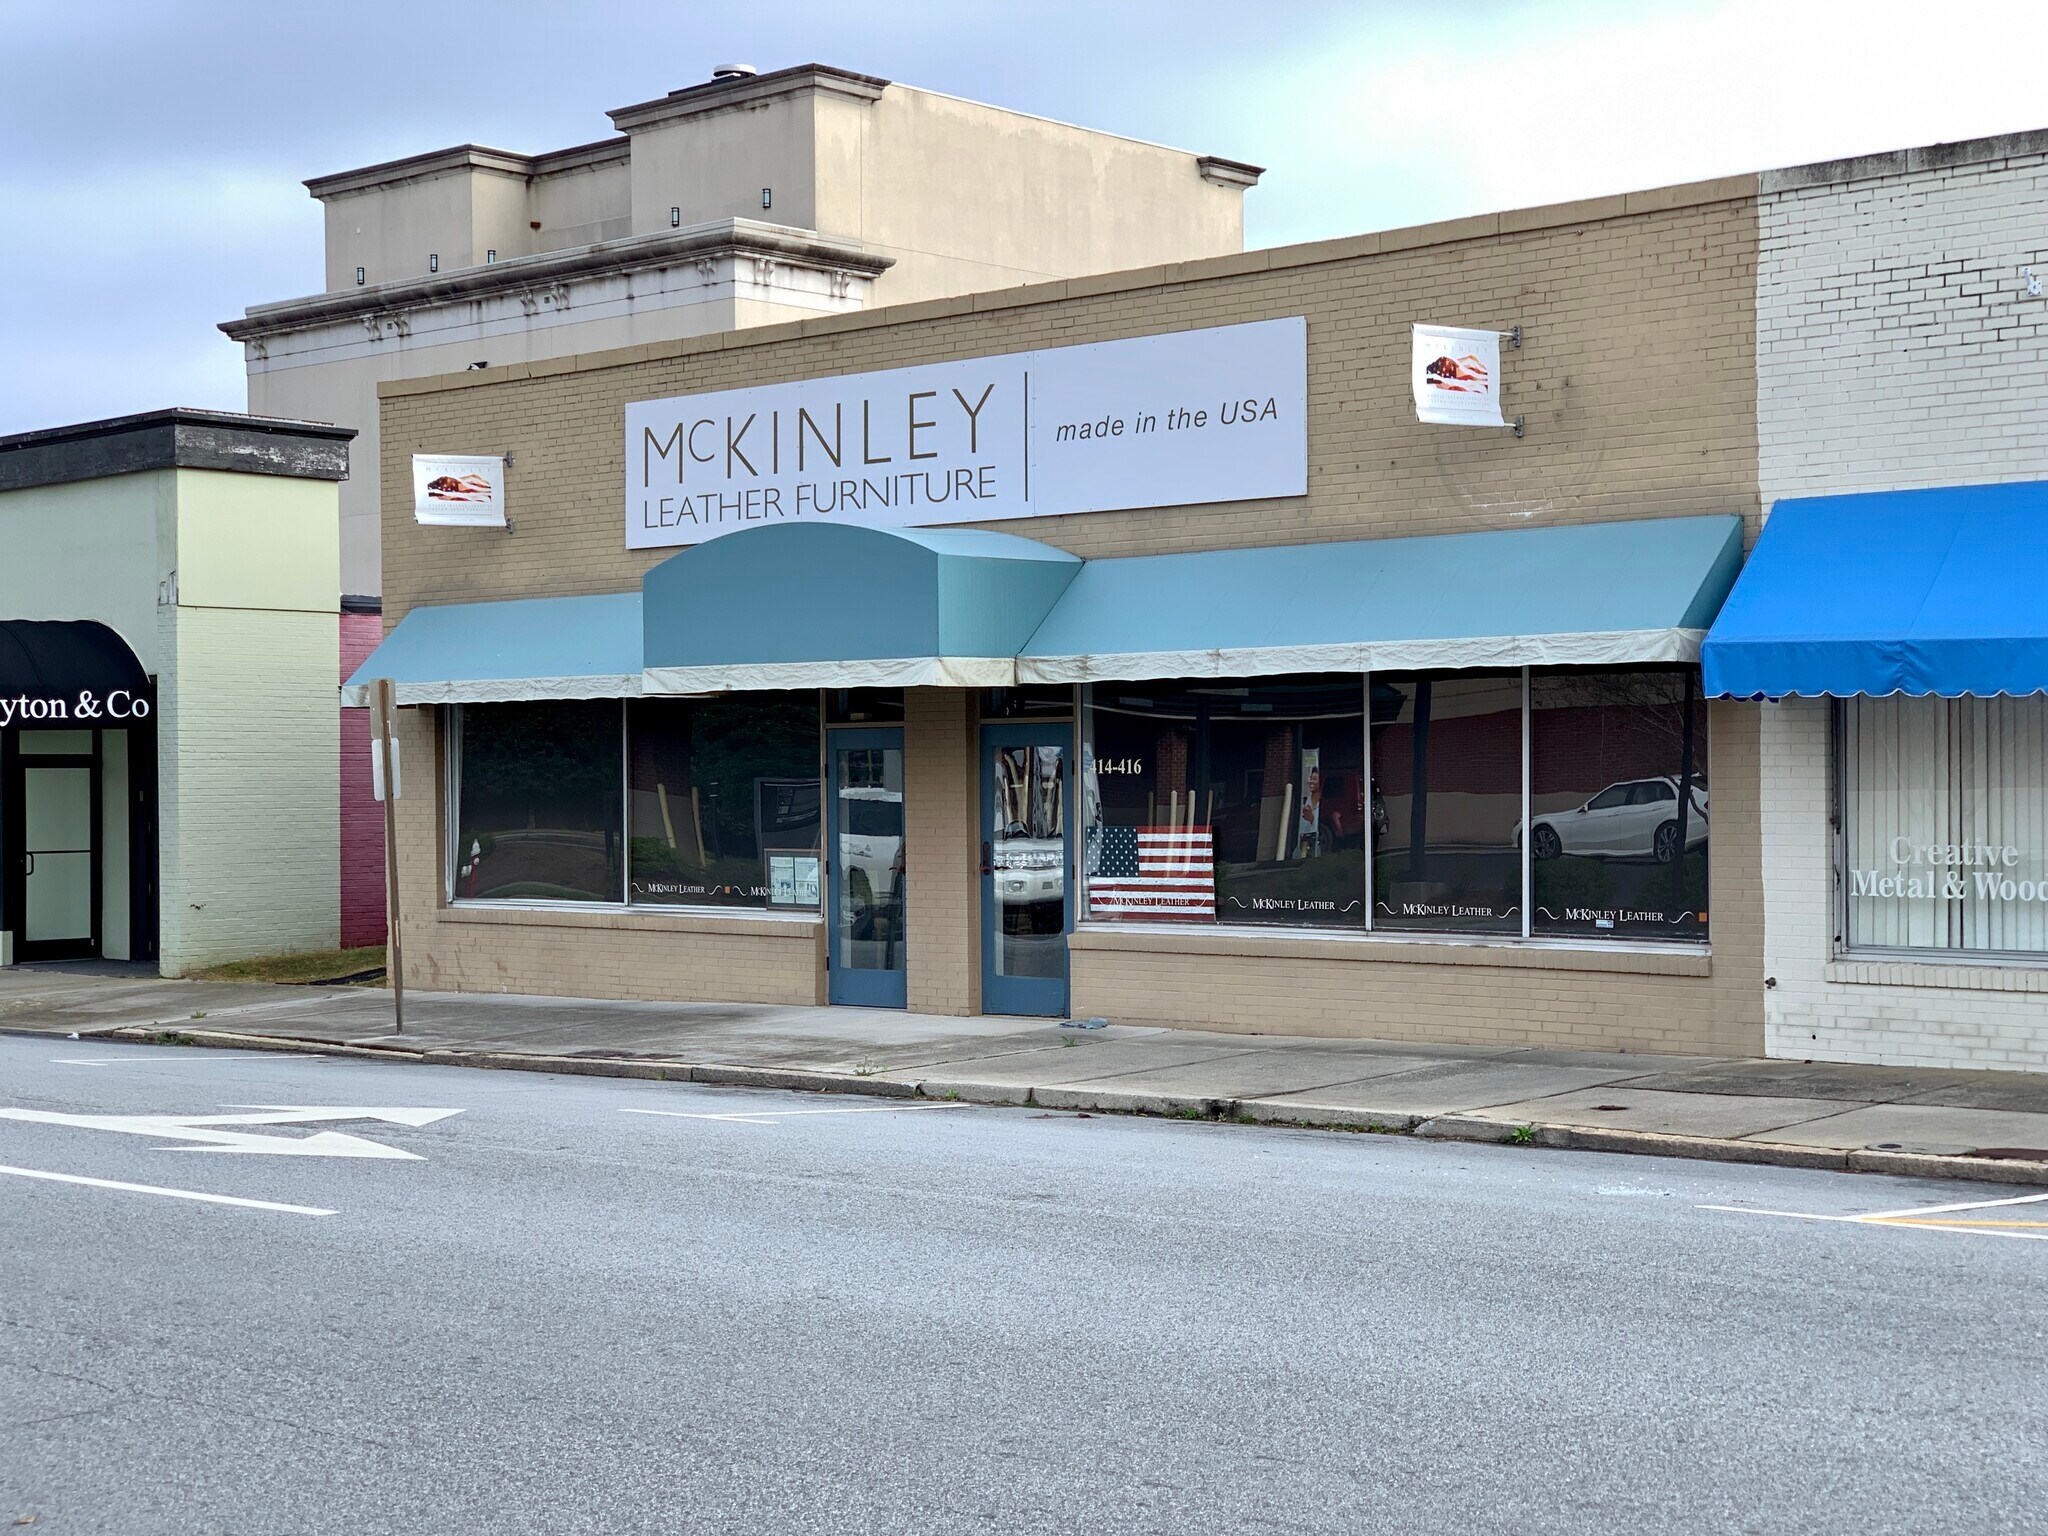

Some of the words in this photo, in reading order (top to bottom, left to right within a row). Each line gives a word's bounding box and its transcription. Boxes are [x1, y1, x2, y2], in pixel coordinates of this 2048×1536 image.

[1056, 417, 1124, 442] made
[1135, 408, 1157, 434] in
[1167, 403, 1208, 430] the
[1219, 396, 1279, 425] USA
[644, 489, 783, 529] LEATHER
[796, 466, 996, 517] FURNITURE
[74, 690, 103, 719] &
[107, 690, 150, 718] Co
[1090, 758, 1142, 774] 414-416
[1889, 836, 2019, 867] Creative
[679, 884, 706, 894] LEATHER
[1850, 869, 1936, 899] Metal
[1942, 870, 1967, 900] &
[1297, 899, 1335, 911] LEATHER
[1452, 904, 1493, 917] LEATHER
[1619, 909, 1664, 922] LEATHER
